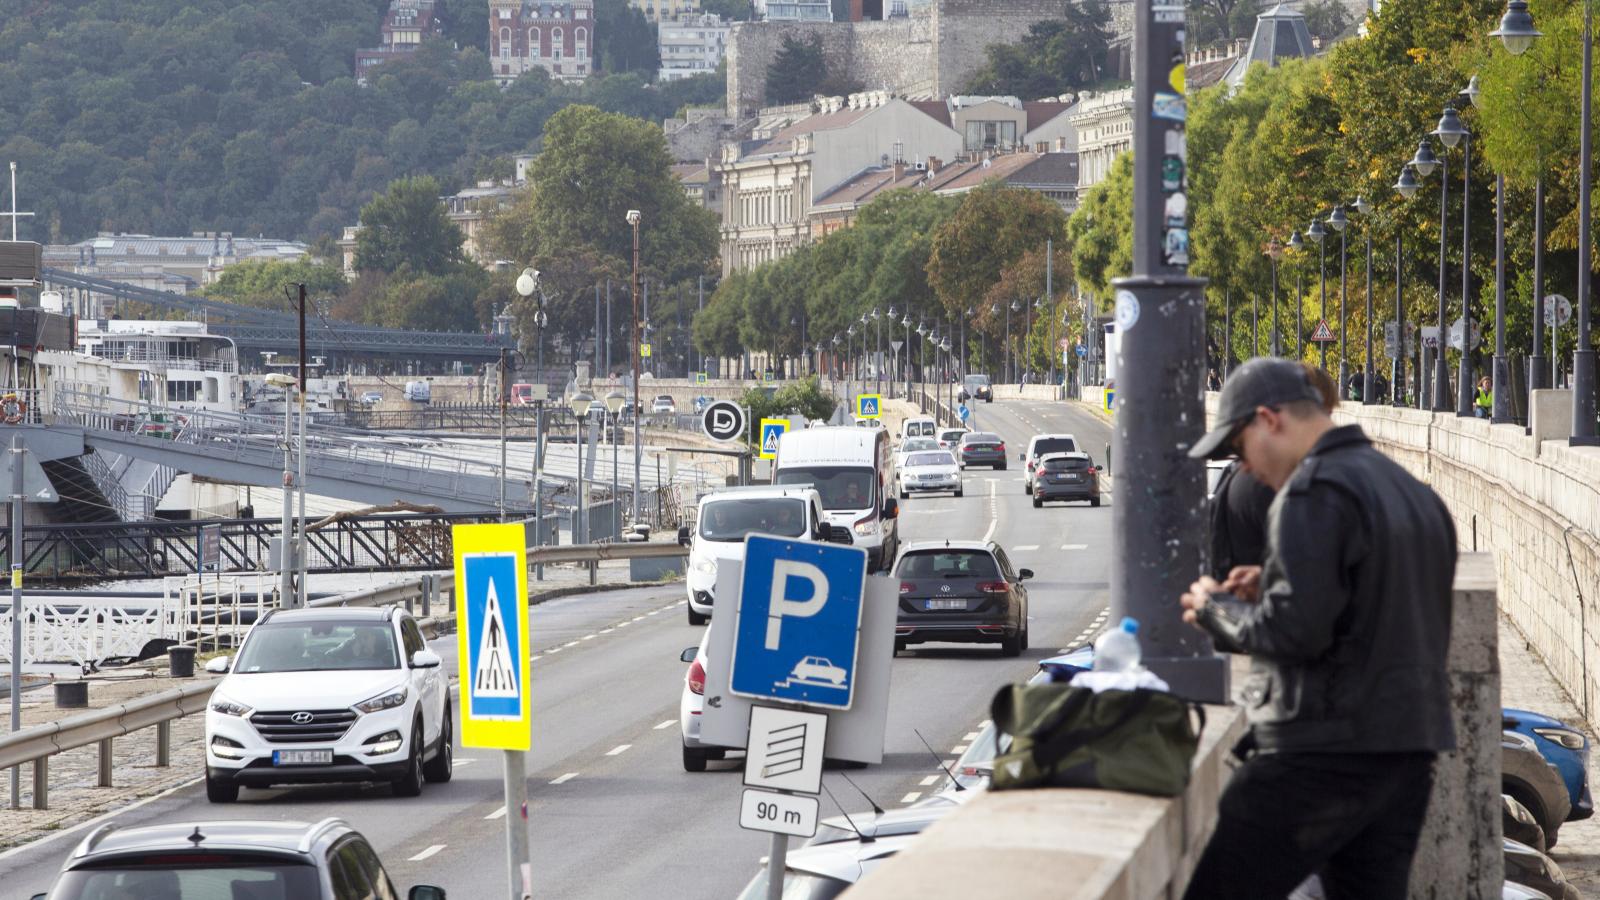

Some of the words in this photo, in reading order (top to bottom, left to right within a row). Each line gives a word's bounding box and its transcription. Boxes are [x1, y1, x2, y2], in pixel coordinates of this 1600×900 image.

[764, 558, 829, 651] P
[757, 801, 778, 821] 90
[784, 810, 801, 824] m
